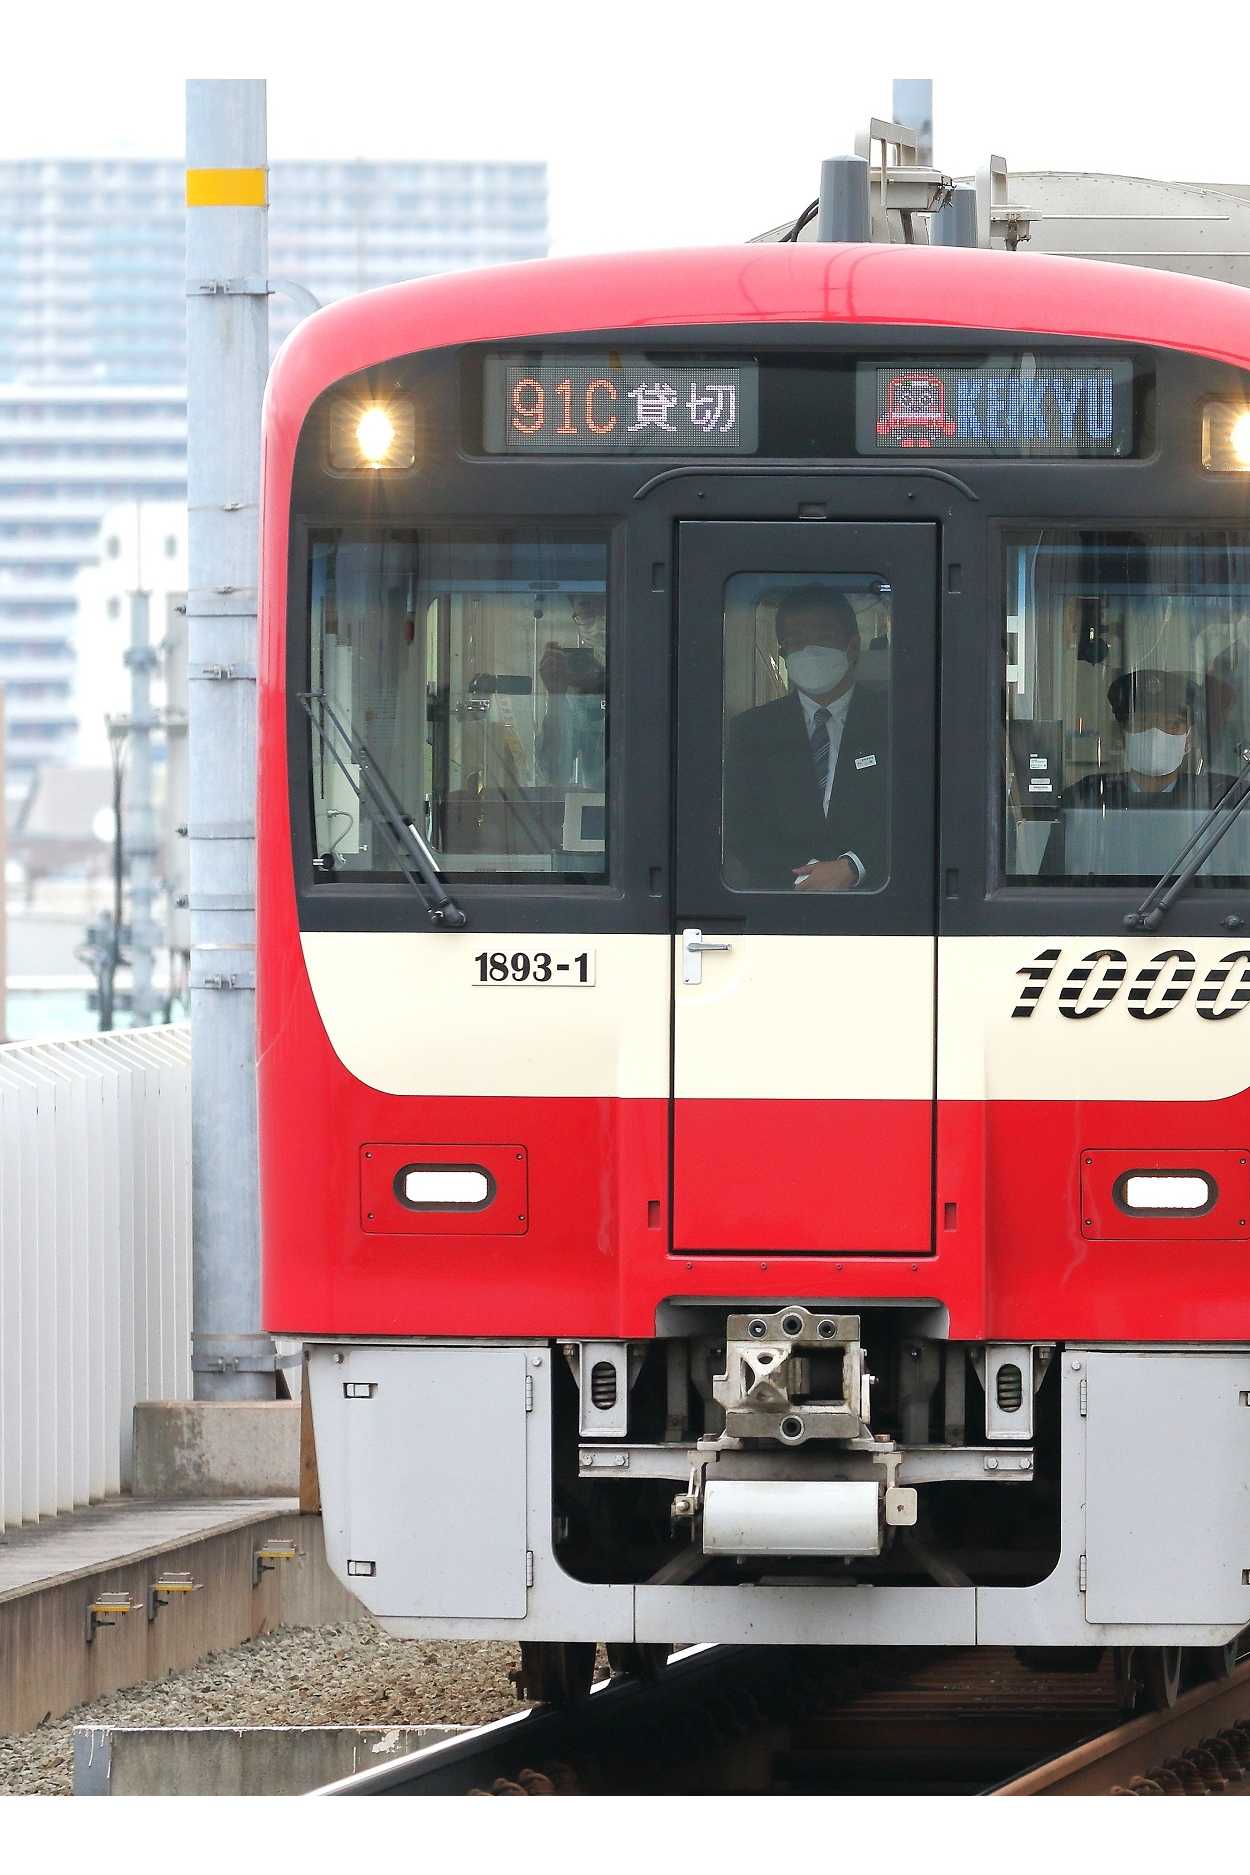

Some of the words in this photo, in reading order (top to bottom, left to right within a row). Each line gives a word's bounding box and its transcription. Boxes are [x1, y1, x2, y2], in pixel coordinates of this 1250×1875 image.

[511, 376, 619, 434] 91C
[627, 382, 736, 433] 貸切
[956, 377, 1113, 438] KEIKYU
[474, 952, 588, 982] 1893-1
